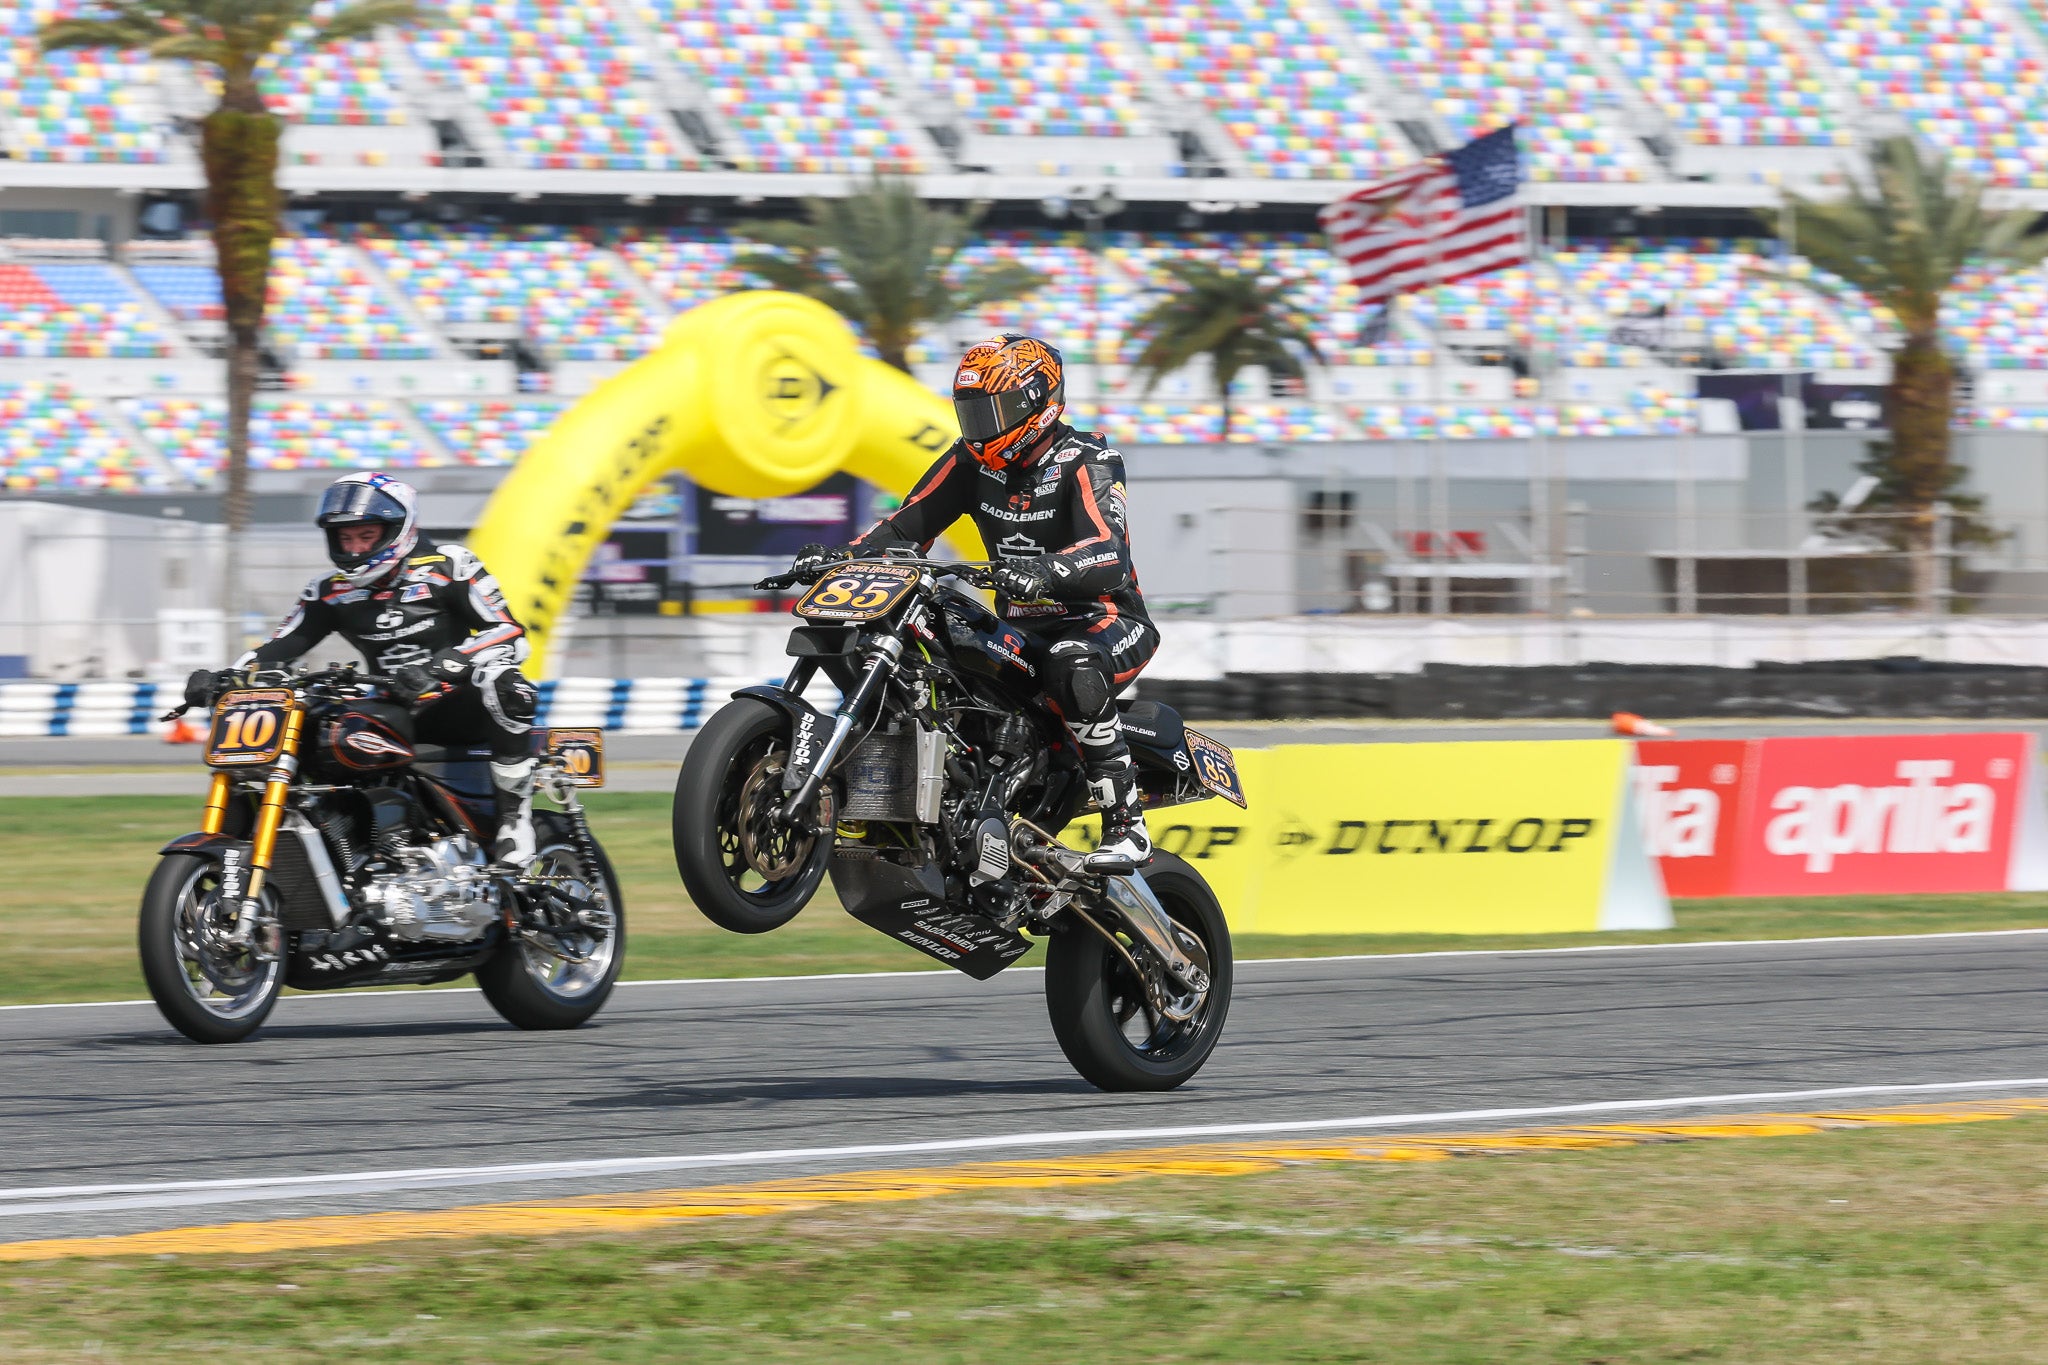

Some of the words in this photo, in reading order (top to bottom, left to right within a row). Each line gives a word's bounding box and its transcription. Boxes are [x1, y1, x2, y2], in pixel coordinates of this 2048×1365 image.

[1041, 408, 1057, 425] BELL
[1057, 450, 1078, 460] BELL
[979, 502, 1056, 523] SADDLEMEN
[813, 579, 900, 609] 85
[986, 640, 1028, 669] SADDLEMEN
[217, 709, 277, 750] 10
[791, 711, 817, 766] DUNLOP
[1203, 755, 1232, 788] 85
[1765, 759, 1996, 873] aprilia
[1323, 817, 1596, 855] DUNLOP
[898, 930, 961, 960] DUNLOP
[914, 920, 979, 952] SADDLEMEN
